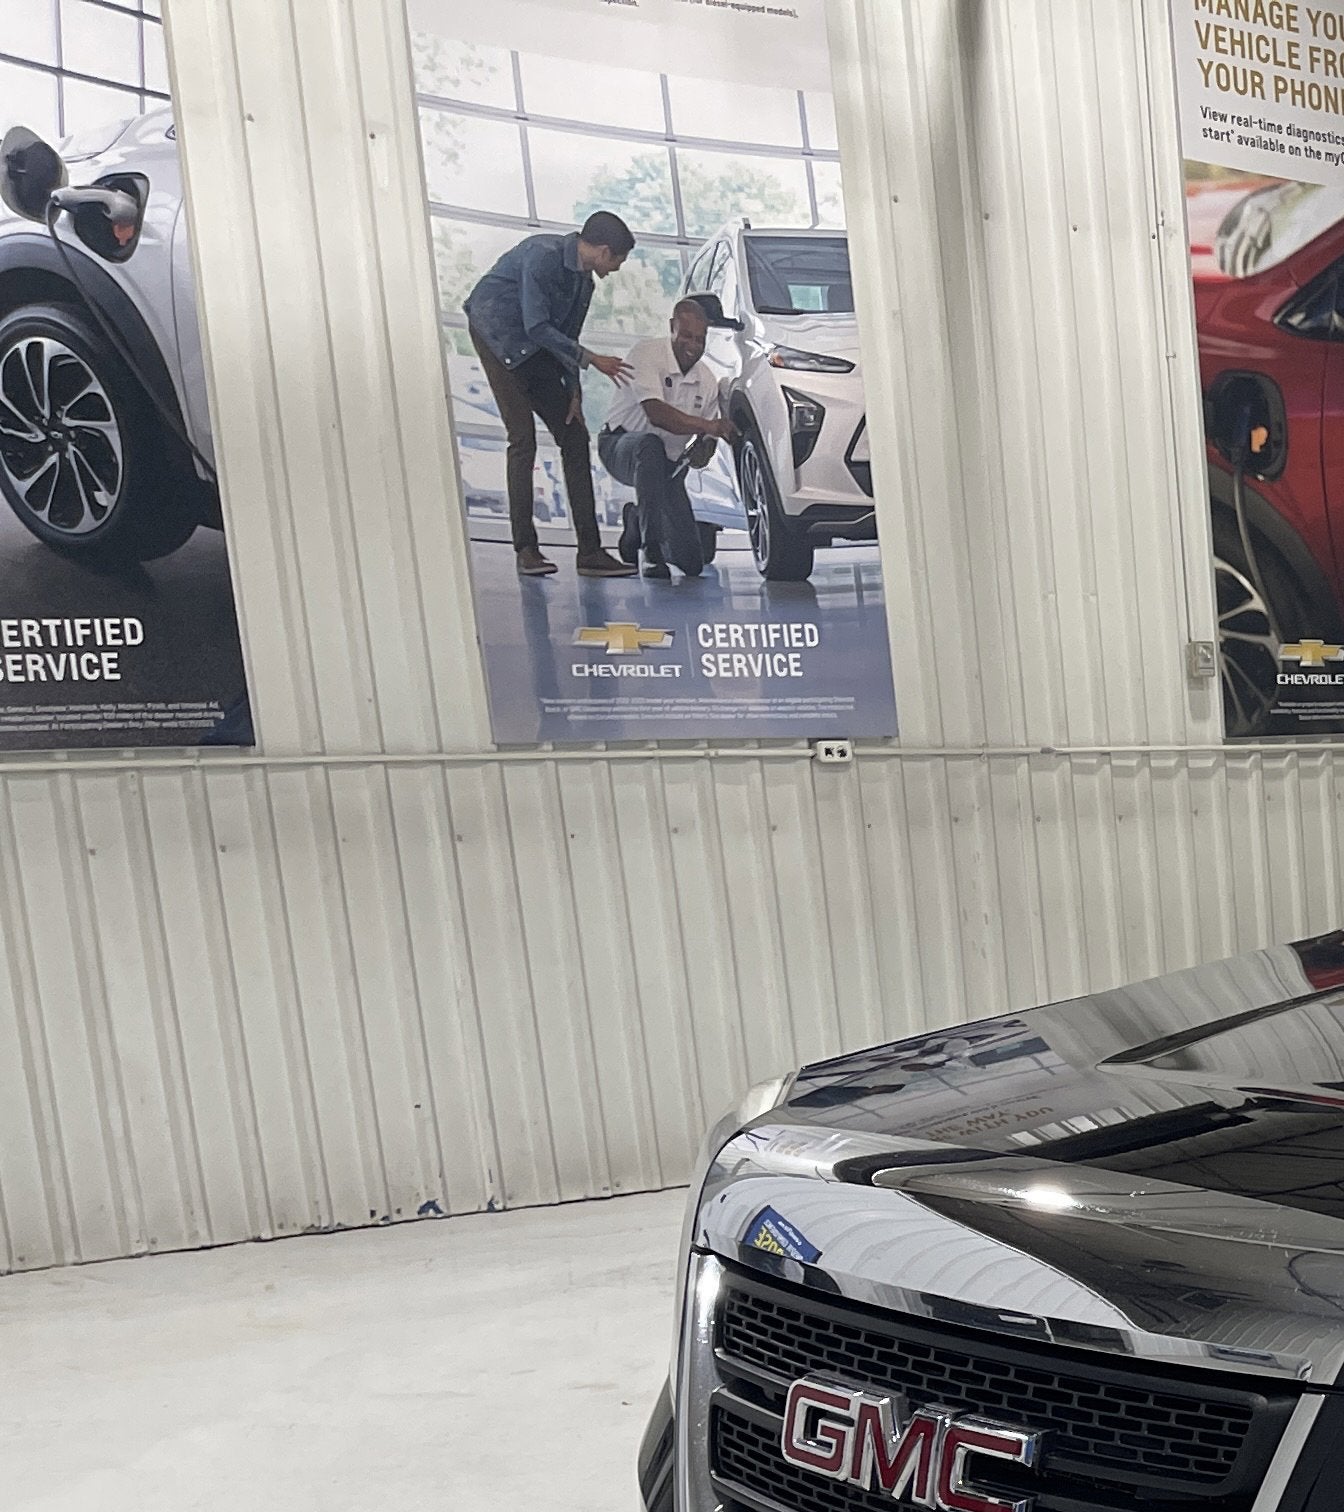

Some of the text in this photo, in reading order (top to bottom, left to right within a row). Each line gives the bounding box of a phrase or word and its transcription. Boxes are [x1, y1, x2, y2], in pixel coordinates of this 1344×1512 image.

[1194, 20, 1301, 71] VEHICLE
[1197, 58, 1266, 100] YOUR
[1200, 105, 1228, 123] View
[1230, 113, 1283, 135] real-time
[1237, 134, 1285, 155] available
[1288, 144, 1302, 157] on
[1304, 146, 1322, 160] the
[0, 617, 145, 648] ERTIFIED
[697, 623, 819, 648] CERTIFIED
[0, 652, 121, 682] ERVICE
[571, 663, 683, 678] CHEVROLET
[701, 653, 803, 678] SERVICE
